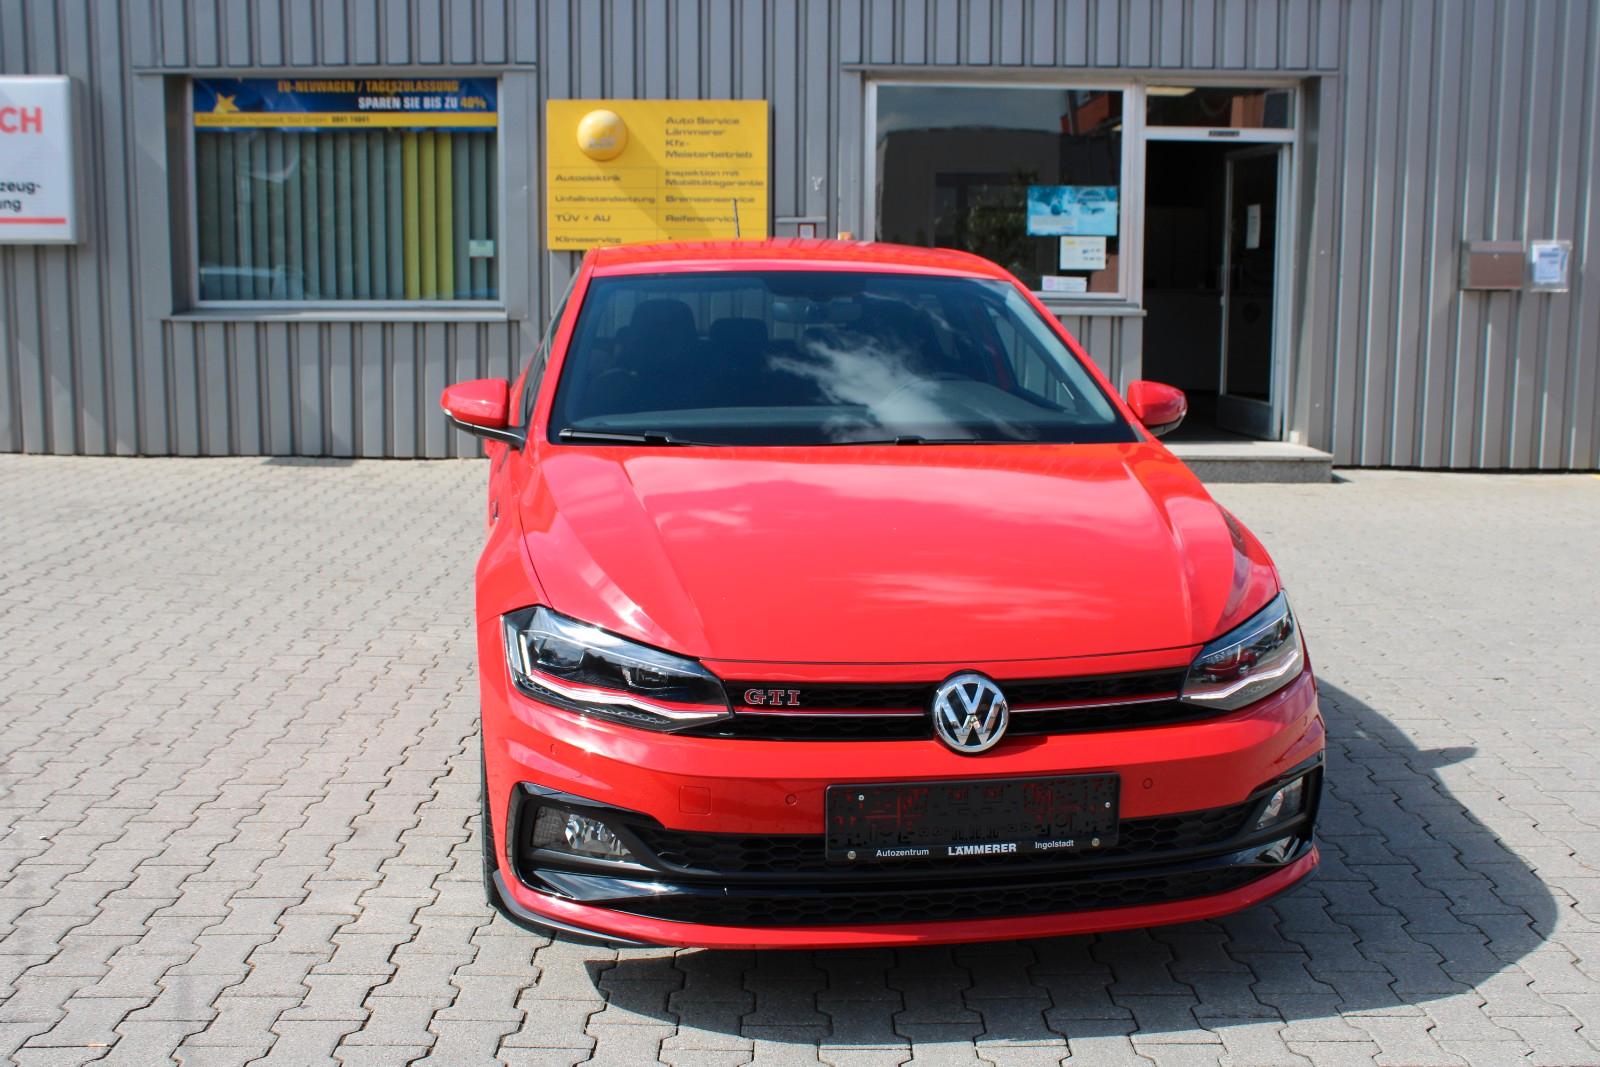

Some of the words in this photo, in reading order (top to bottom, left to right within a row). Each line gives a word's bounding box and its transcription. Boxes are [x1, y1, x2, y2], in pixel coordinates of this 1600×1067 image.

[358, 96, 401, 109] SPAREN
[403, 96, 420, 109] SIE
[422, 96, 442, 109] BIS
[444, 96, 459, 109] ZU
[665, 116, 696, 125] Auto
[697, 116, 740, 125] Service
[665, 139, 689, 147] Kfz-
[665, 150, 752, 159] Meisterbetrieb
[555, 212, 580, 222] TÜV
[593, 214, 611, 222] AU
[744, 688, 801, 706] GTI
[876, 848, 930, 858] Autozentrum
[948, 843, 1017, 857] LÄMMERER
[1034, 839, 1075, 850] Ingolstadt
